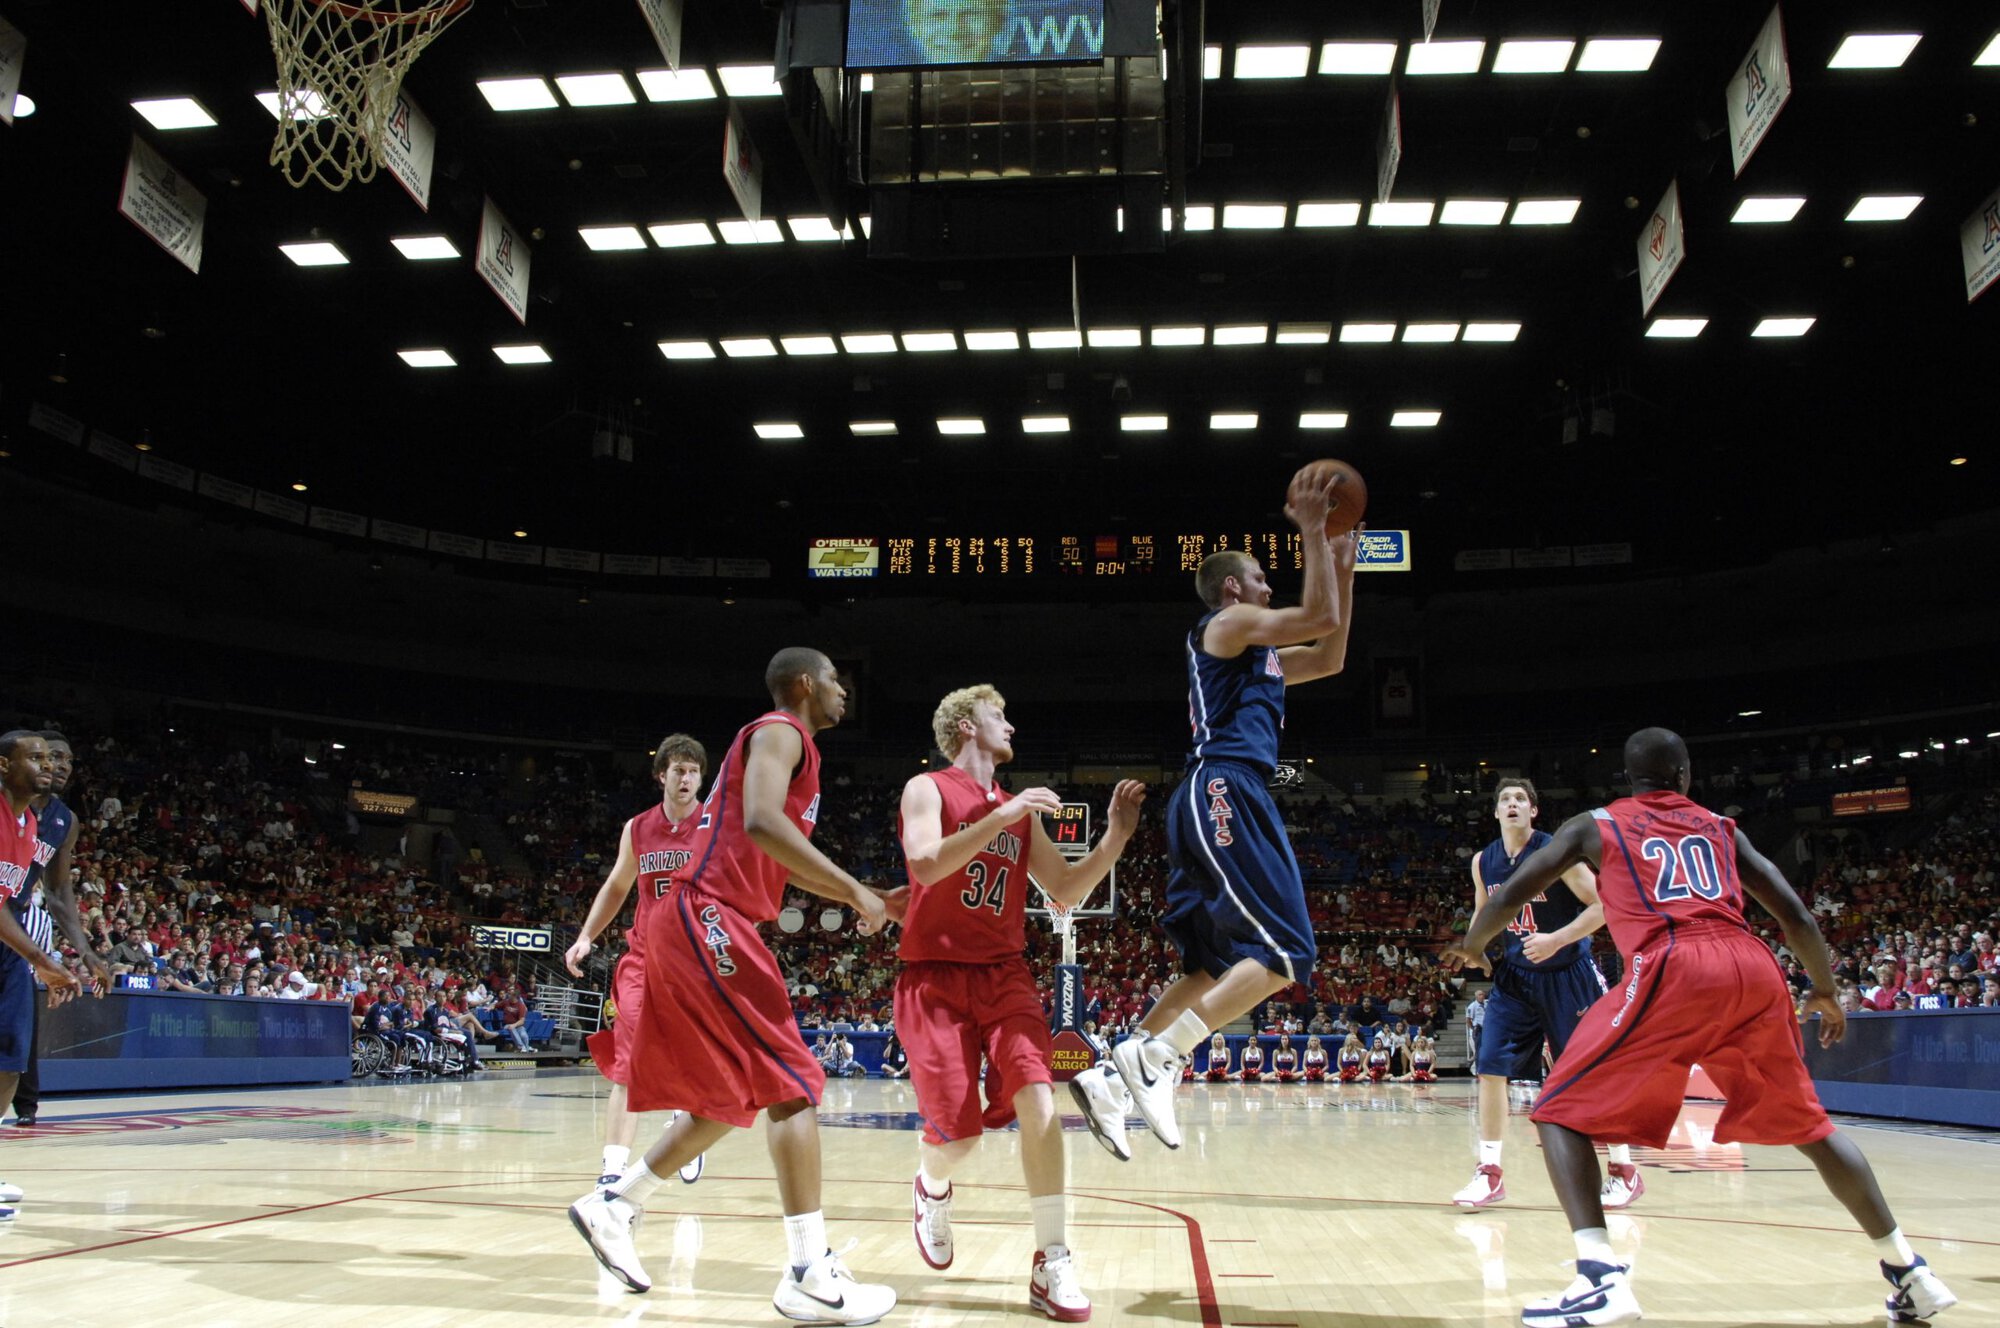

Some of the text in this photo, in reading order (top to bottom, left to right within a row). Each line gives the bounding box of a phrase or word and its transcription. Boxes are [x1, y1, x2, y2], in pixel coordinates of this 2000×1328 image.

[888, 538, 1033, 547] PLYR 5 20 34 42 50
[1062, 537, 1077, 545] RED
[1132, 536, 1153, 544] BLUE
[1178, 535, 1204, 544] PLYR
[1244, 534, 1252, 542] 2
[1263, 534, 1277, 542] 12
[1359, 535, 1391, 543] Tucson
[1183, 544, 1201, 552] PTS
[1362, 542, 1398, 550] Electric
[892, 548, 911, 556] PTS
[952, 547, 960, 555] 2
[1026, 547, 1033, 555] 4
[1063, 548, 1080, 560] 50
[1136, 547, 1153, 559] 59
[1366, 550, 1398, 558] Power
[891, 556, 912, 565] RBS
[1181, 553, 1202, 561] RBS
[815, 569, 873, 577] WATSON
[928, 565, 936, 573] 2
[952, 565, 960, 573] 2
[976, 565, 984, 573] 0
[1001, 565, 1008, 573] 3
[1025, 565, 1033, 573] 3
[1096, 562, 1125, 574] 8:04
[363, 804, 405, 814] 327-7463
[1208, 778, 1233, 846] CATS
[1058, 823, 1078, 842] 14
[1641, 834, 1722, 902] 20
[961, 860, 1008, 916] 34
[475, 928, 550, 948] GEICO
[700, 905, 737, 976] CATS
[128, 976, 150, 989] POSS.
[1063, 969, 1074, 1027] ARIZONA
[1920, 996, 1940, 1010] POSS.
[150, 1013, 161, 1037] At
[164, 1014, 182, 1037] the
[185, 1014, 208, 1038] line.
[211, 1016, 240, 1038] Down
[264, 1017, 282, 1039] Two
[284, 1018, 306, 1039] ticks
[308, 1018, 327, 1040] left.
